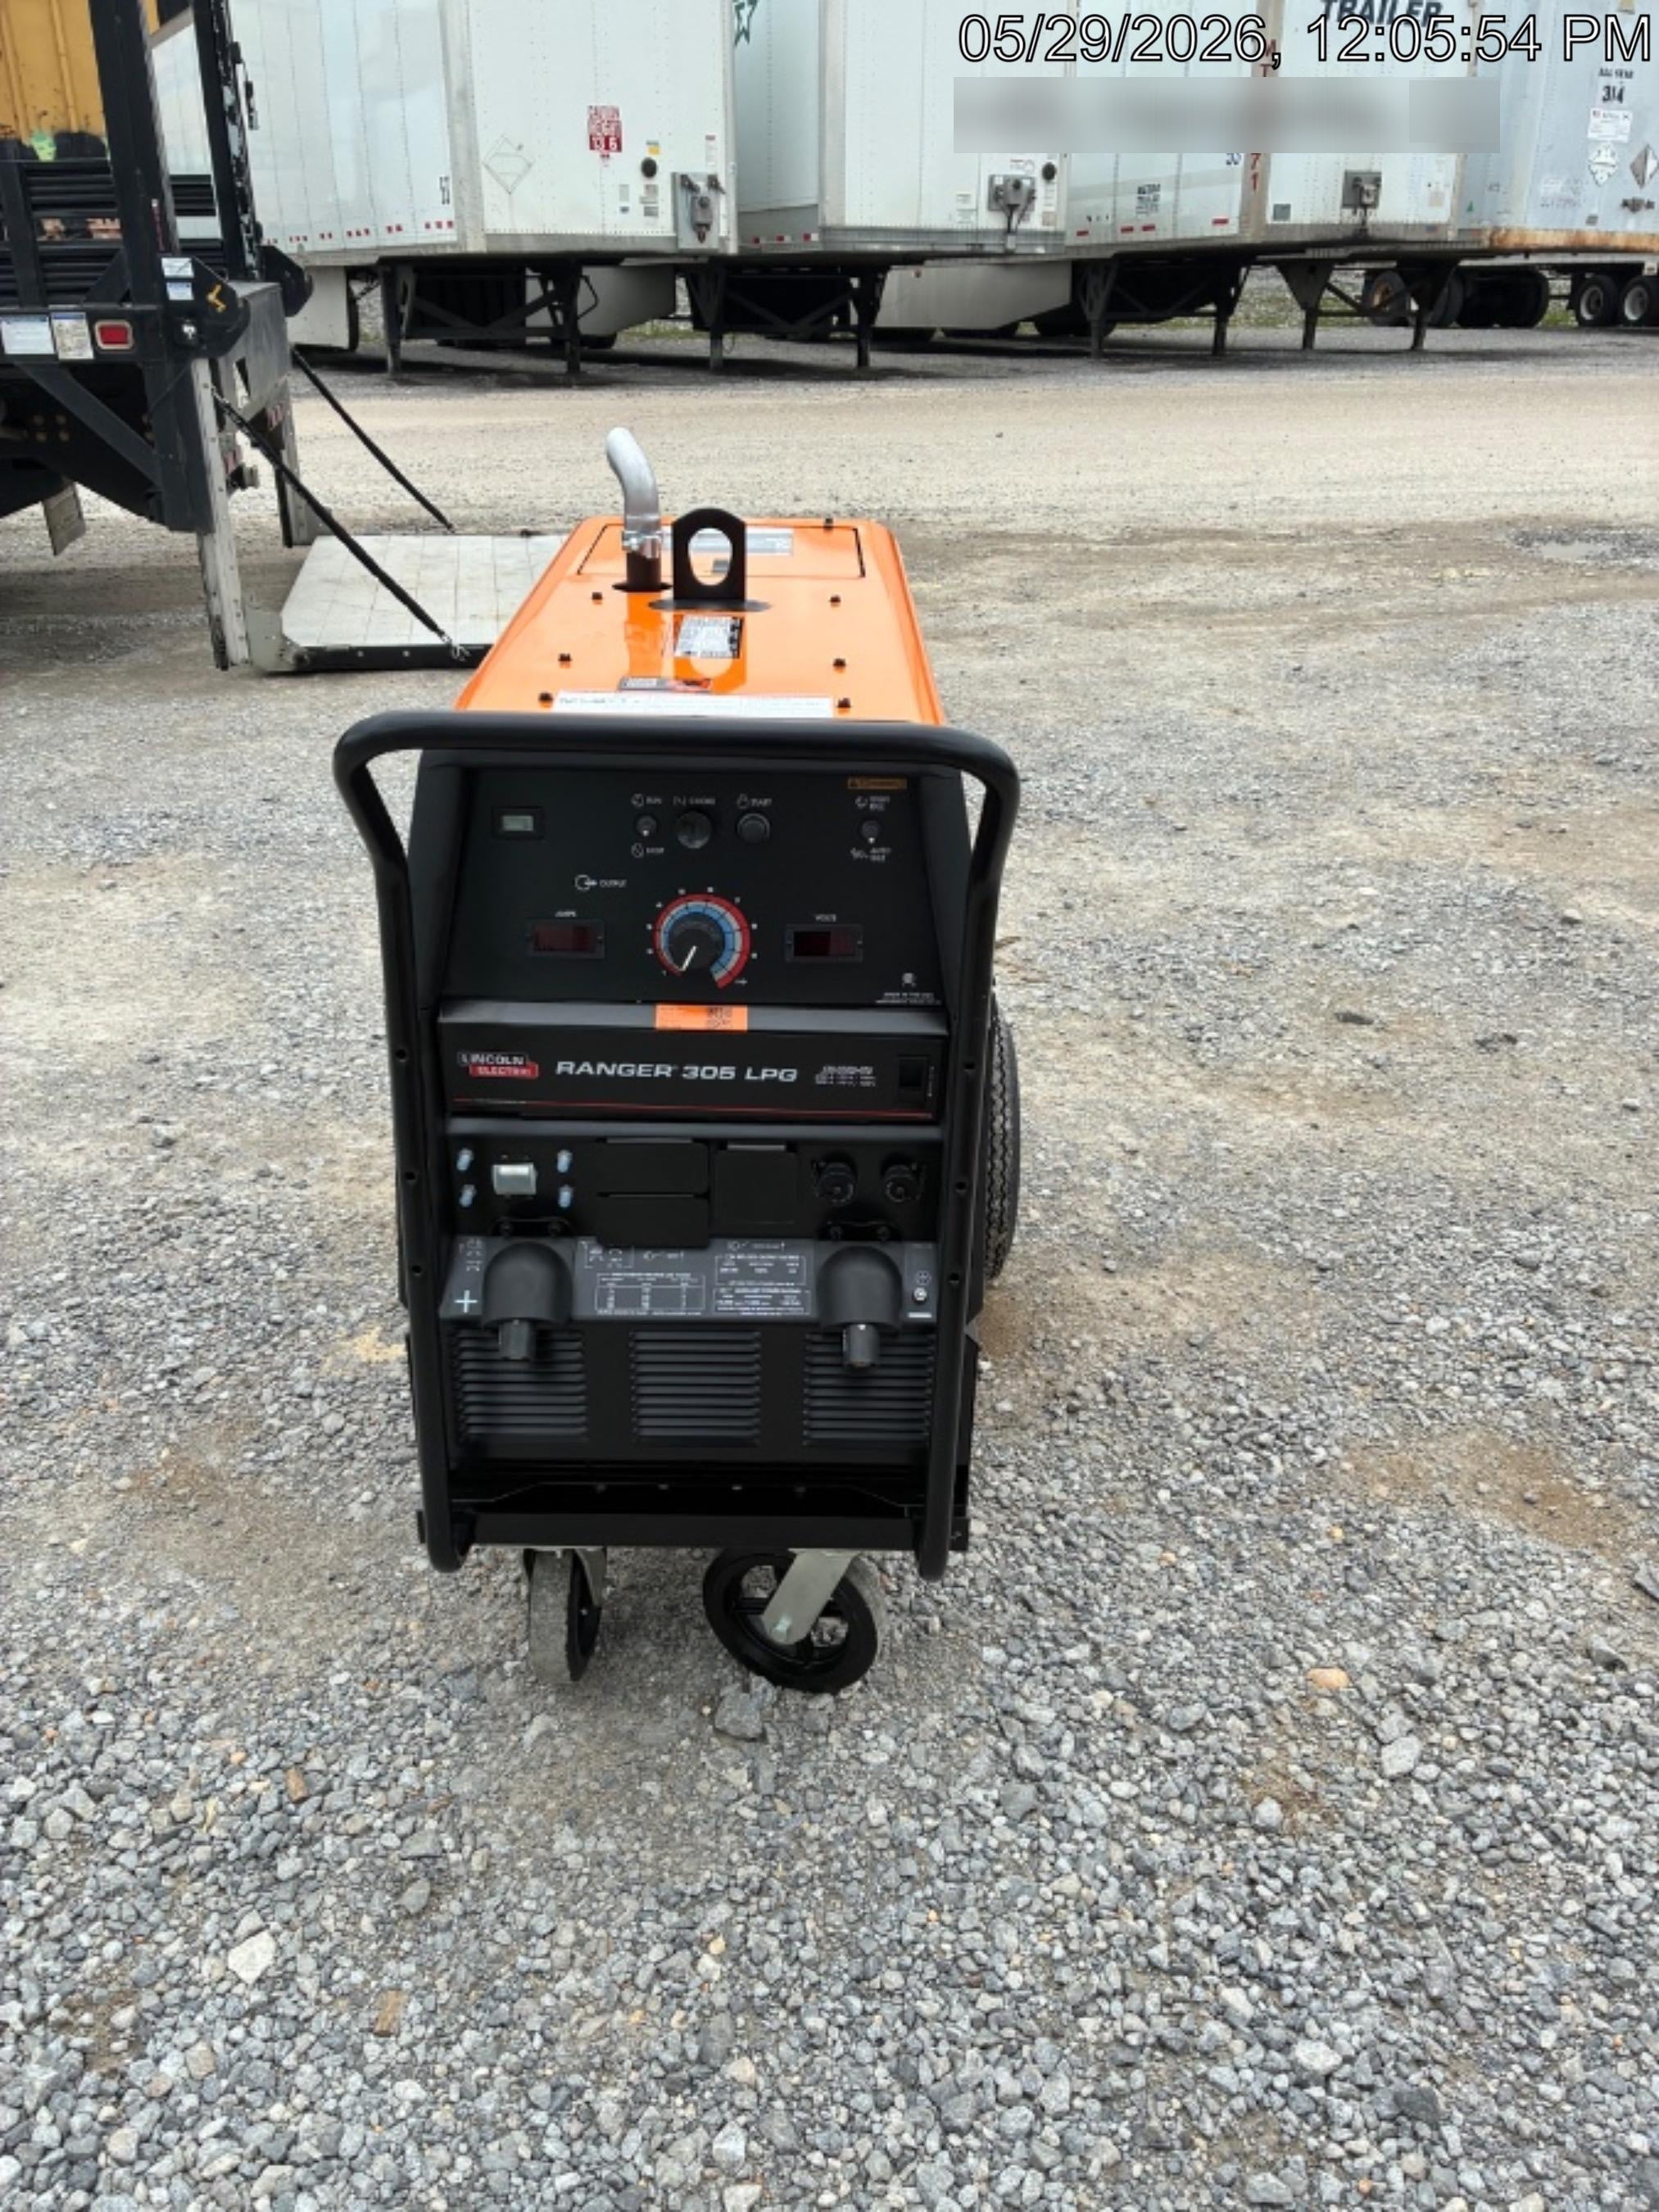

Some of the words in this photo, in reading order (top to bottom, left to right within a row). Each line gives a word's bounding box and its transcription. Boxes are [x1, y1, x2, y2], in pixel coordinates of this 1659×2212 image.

[460, 1052, 524, 1065] LINCOLN
[555, 1060, 673, 1078] RANGER
[682, 1065, 736, 1081] 305
[743, 1067, 798, 1083] LPG
